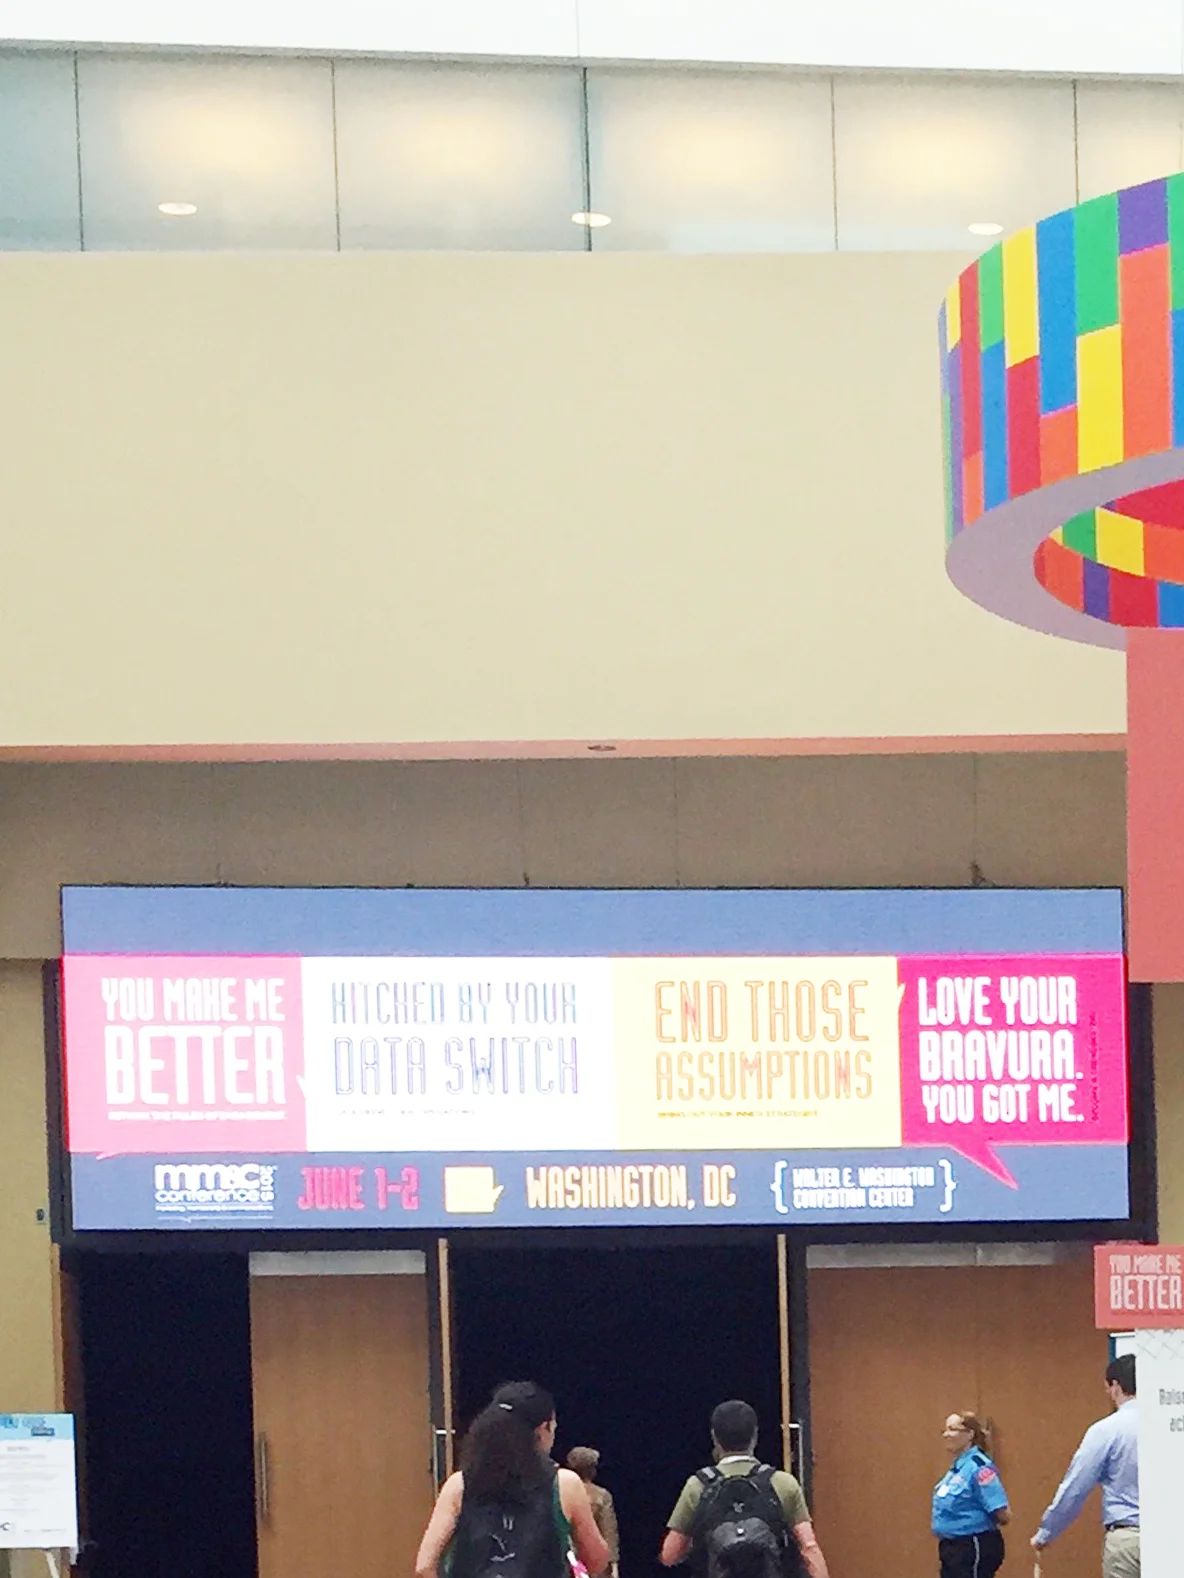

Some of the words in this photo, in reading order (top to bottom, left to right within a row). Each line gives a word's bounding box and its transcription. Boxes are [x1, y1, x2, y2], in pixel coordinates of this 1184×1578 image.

[101, 977, 154, 1023] YOU
[163, 977, 237, 1023] MAKE
[246, 977, 285, 1022] ME
[332, 982, 444, 1024] HITCHED
[458, 982, 490, 1024] BY
[506, 982, 577, 1024] YOUR
[655, 980, 728, 1043] END
[745, 979, 869, 1043] THOSE
[918, 976, 991, 1025] LOVE
[1001, 976, 1077, 1025] YOUR
[104, 1025, 286, 1105] BETTER
[335, 1037, 426, 1095] DATA
[444, 1037, 578, 1095] SWITCH
[656, 1049, 873, 1101] ASSUMPTIONS
[919, 1030, 1084, 1081] BRAVURA.
[922, 1085, 975, 1124] YOU
[983, 1084, 1030, 1123] GOT
[1039, 1083, 1084, 1123] ME.
[155, 1189, 260, 1202] conference
[297, 1165, 365, 1211] JUNE
[374, 1165, 419, 1211] 1-2
[526, 1164, 695, 1210] WASHINGTON,
[703, 1164, 736, 1207] DC
[792, 1168, 841, 1188] WALTER
[858, 1166, 934, 1187] WASHINGTON
[793, 1188, 866, 1209] CONVENTION
[868, 1188, 914, 1208] CENTER
[1110, 1255, 1131, 1273] YOU
[1166, 1254, 1183, 1273] ME
[1110, 1274, 1182, 1310] BETTER
